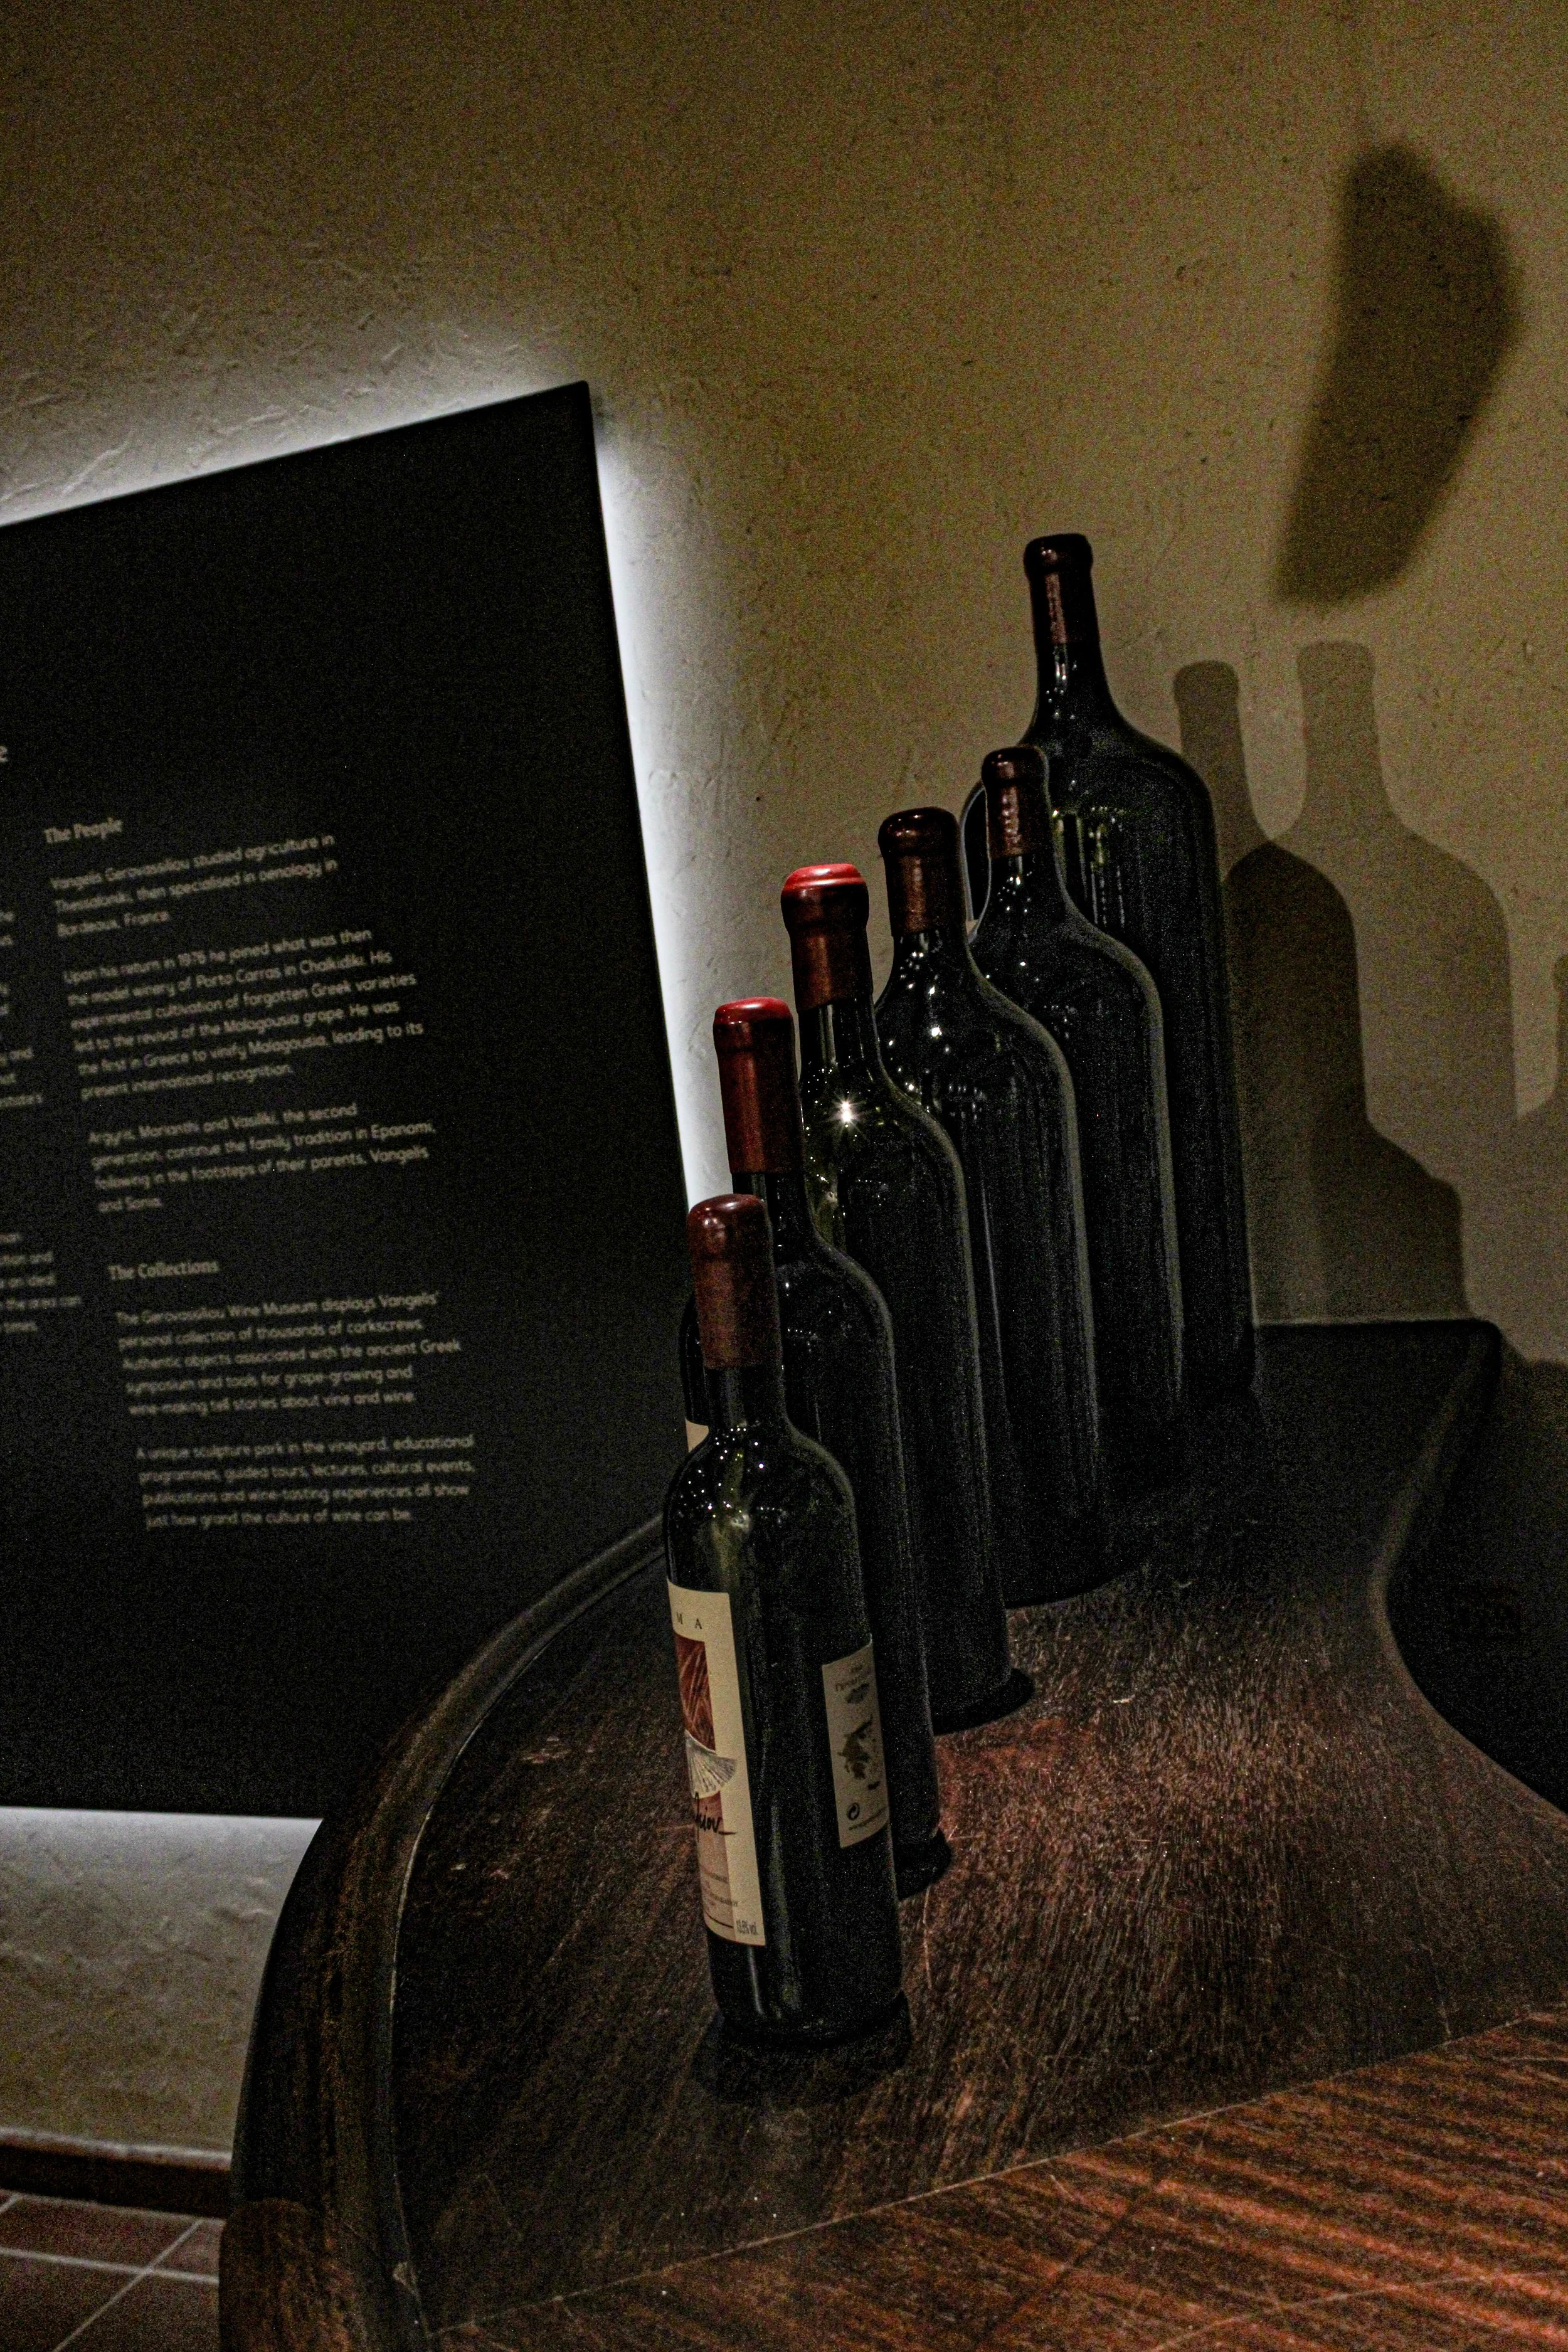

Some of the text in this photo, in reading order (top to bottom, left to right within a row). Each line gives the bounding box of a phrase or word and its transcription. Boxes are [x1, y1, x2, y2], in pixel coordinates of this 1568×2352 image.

[192, 846, 243, 868] studied
[243, 837, 319, 862] agriculture
[321, 834, 335, 845] in
[167, 872, 241, 899] specialised
[242, 871, 257, 884] in
[324, 859, 337, 871] in
[162, 958, 176, 969] in
[208, 950, 226, 962] he
[228, 941, 270, 964] joined
[272, 937, 307, 953] what
[309, 934, 337, 948] was
[339, 930, 372, 944] then
[177, 975, 191, 992] of
[194, 973, 234, 988] Porto
[235, 967, 282, 983] Carras
[283, 965, 297, 977] in
[369, 950, 393, 963] His
[224, 993, 240, 1009] of
[242, 987, 309, 1009] forgotten
[310, 980, 352, 998] Greek
[355, 973, 416, 991] varieties
[180, 1023, 196, 1039] of
[198, 1022, 222, 1037] the
[348, 1004, 369, 1016] He
[372, 1001, 400, 1014] was
[191, 1049, 208, 1062] to
[209, 1042, 247, 1061] vinify
[331, 1027, 384, 1044] leading
[386, 1025, 403, 1037] to
[405, 1022, 423, 1035] its
[202, 1116, 230, 1133] and
[282, 1109, 305, 1123] the
[307, 1102, 358, 1121] second
[165, 1143, 221, 1160] continue
[223, 1140, 246, 1153] the
[248, 1134, 292, 1152] family
[292, 1130, 352, 1147] tradition
[355, 1128, 368, 1140] in
[166, 1170, 189, 1182] the
[191, 1164, 257, 1180] footsteps
[257, 1158, 272, 1175] of
[275, 1158, 307, 1172] their
[368, 1145, 429, 1165] Vangelis
[226, 1305, 261, 1317] Wine
[262, 1301, 318, 1316] Museum
[320, 1296, 376, 1314] displays
[174, 1330, 236, 1345] collection
[238, 1325, 253, 1341] of
[255, 1322, 326, 1340] thousands
[327, 1320, 342, 1336] of
[183, 1353, 232, 1370] objects
[233, 1347, 307, 1364] associated
[308, 1345, 338, 1360] with
[339, 1343, 363, 1359] the
[366, 1342, 417, 1357] ancient
[419, 1338, 462, 1354] Greek
[196, 1375, 223, 1389] and
[225, 1373, 258, 1387] tools
[260, 1372, 280, 1386] for
[283, 1369, 384, 1389] grape-growing
[385, 1364, 413, 1379] and
[209, 1397, 230, 1411] tell
[232, 1397, 278, 1411] stories
[280, 1394, 320, 1408] about
[322, 1394, 351, 1406] vine
[352, 1390, 381, 1405] and
[192, 1444, 252, 1459] sculpture
[253, 1441, 284, 1458] park
[287, 1443, 300, 1454] in
[301, 1440, 326, 1453] the
[392, 1433, 475, 1450] educational
[224, 1466, 269, 1483] guided
[371, 1459, 423, 1475] cultural
[220, 1490, 245, 1502] and
[332, 1486, 413, 1501] experiences
[415, 1482, 432, 1497] all
[433, 1483, 470, 1497] show
[200, 1512, 238, 1528] grand
[241, 1512, 262, 1523] the
[265, 1510, 310, 1523] culture
[313, 1508, 327, 1522] of
[331, 1511, 362, 1522] wine
[364, 1510, 389, 1522] can
